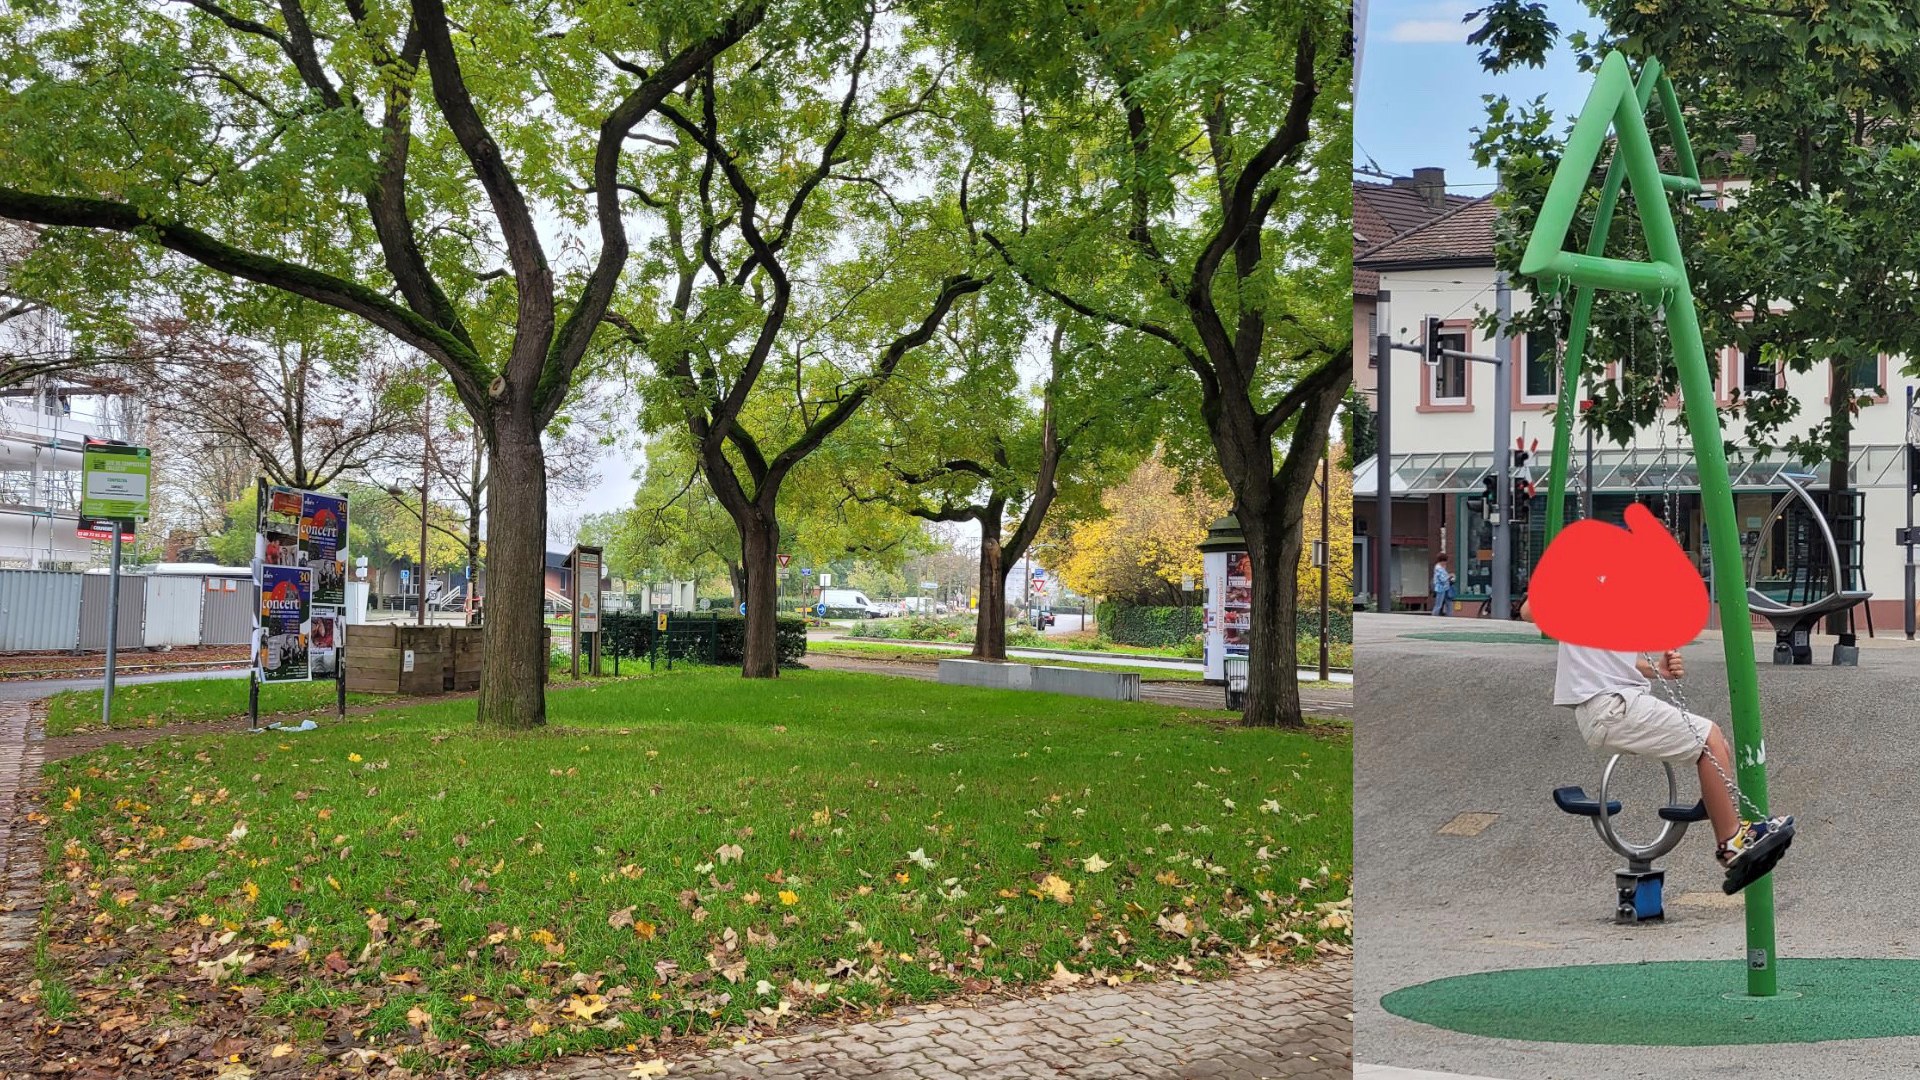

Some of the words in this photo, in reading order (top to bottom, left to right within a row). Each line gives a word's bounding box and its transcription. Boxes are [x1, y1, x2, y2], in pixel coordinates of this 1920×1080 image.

[337, 501, 347, 513] 30
[300, 524, 338, 538] concert
[298, 571, 310, 583] 30
[262, 599, 300, 610] concert
